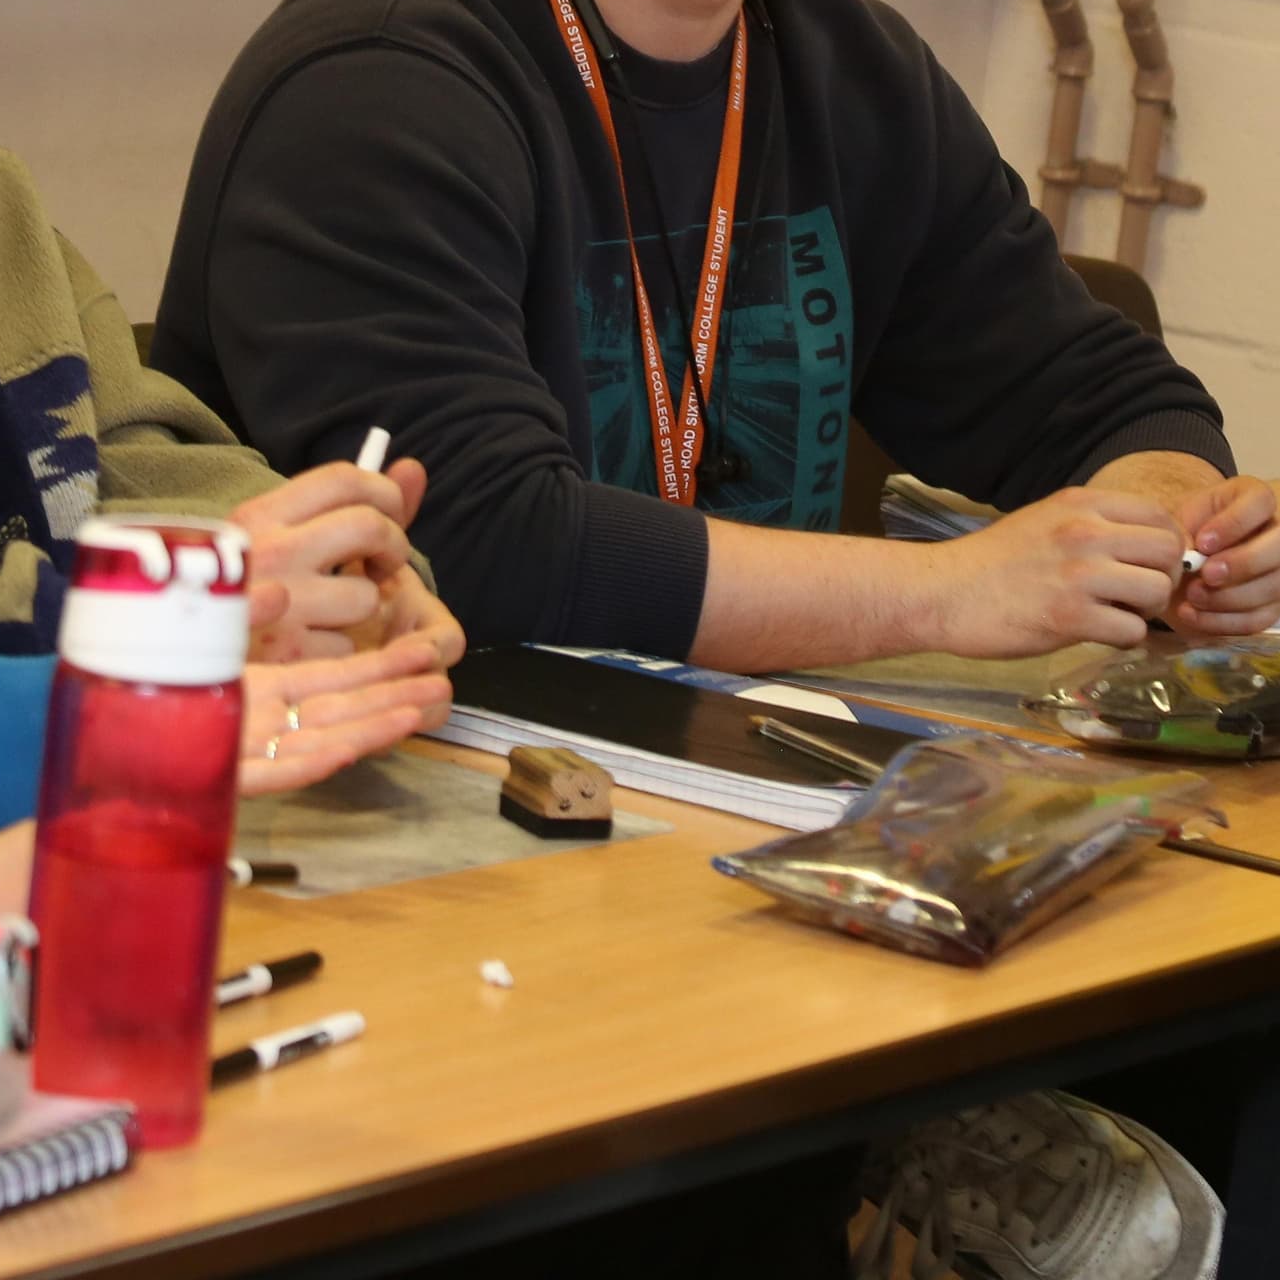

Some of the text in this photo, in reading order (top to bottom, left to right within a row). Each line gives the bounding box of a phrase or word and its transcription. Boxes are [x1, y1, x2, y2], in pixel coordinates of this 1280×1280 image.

[567, 24, 595, 90] STUDENT
[709, 206, 729, 271] STUDENT
[697, 273, 720, 340] COLLEGE
[646, 327, 658, 369] FORM
[694, 342, 709, 384] ORM
[651, 370, 671, 435] COLLEGE
[685, 385, 700, 427] SIXT
[660, 437, 680, 500] STUDENT
[681, 428, 696, 470] ROAD
